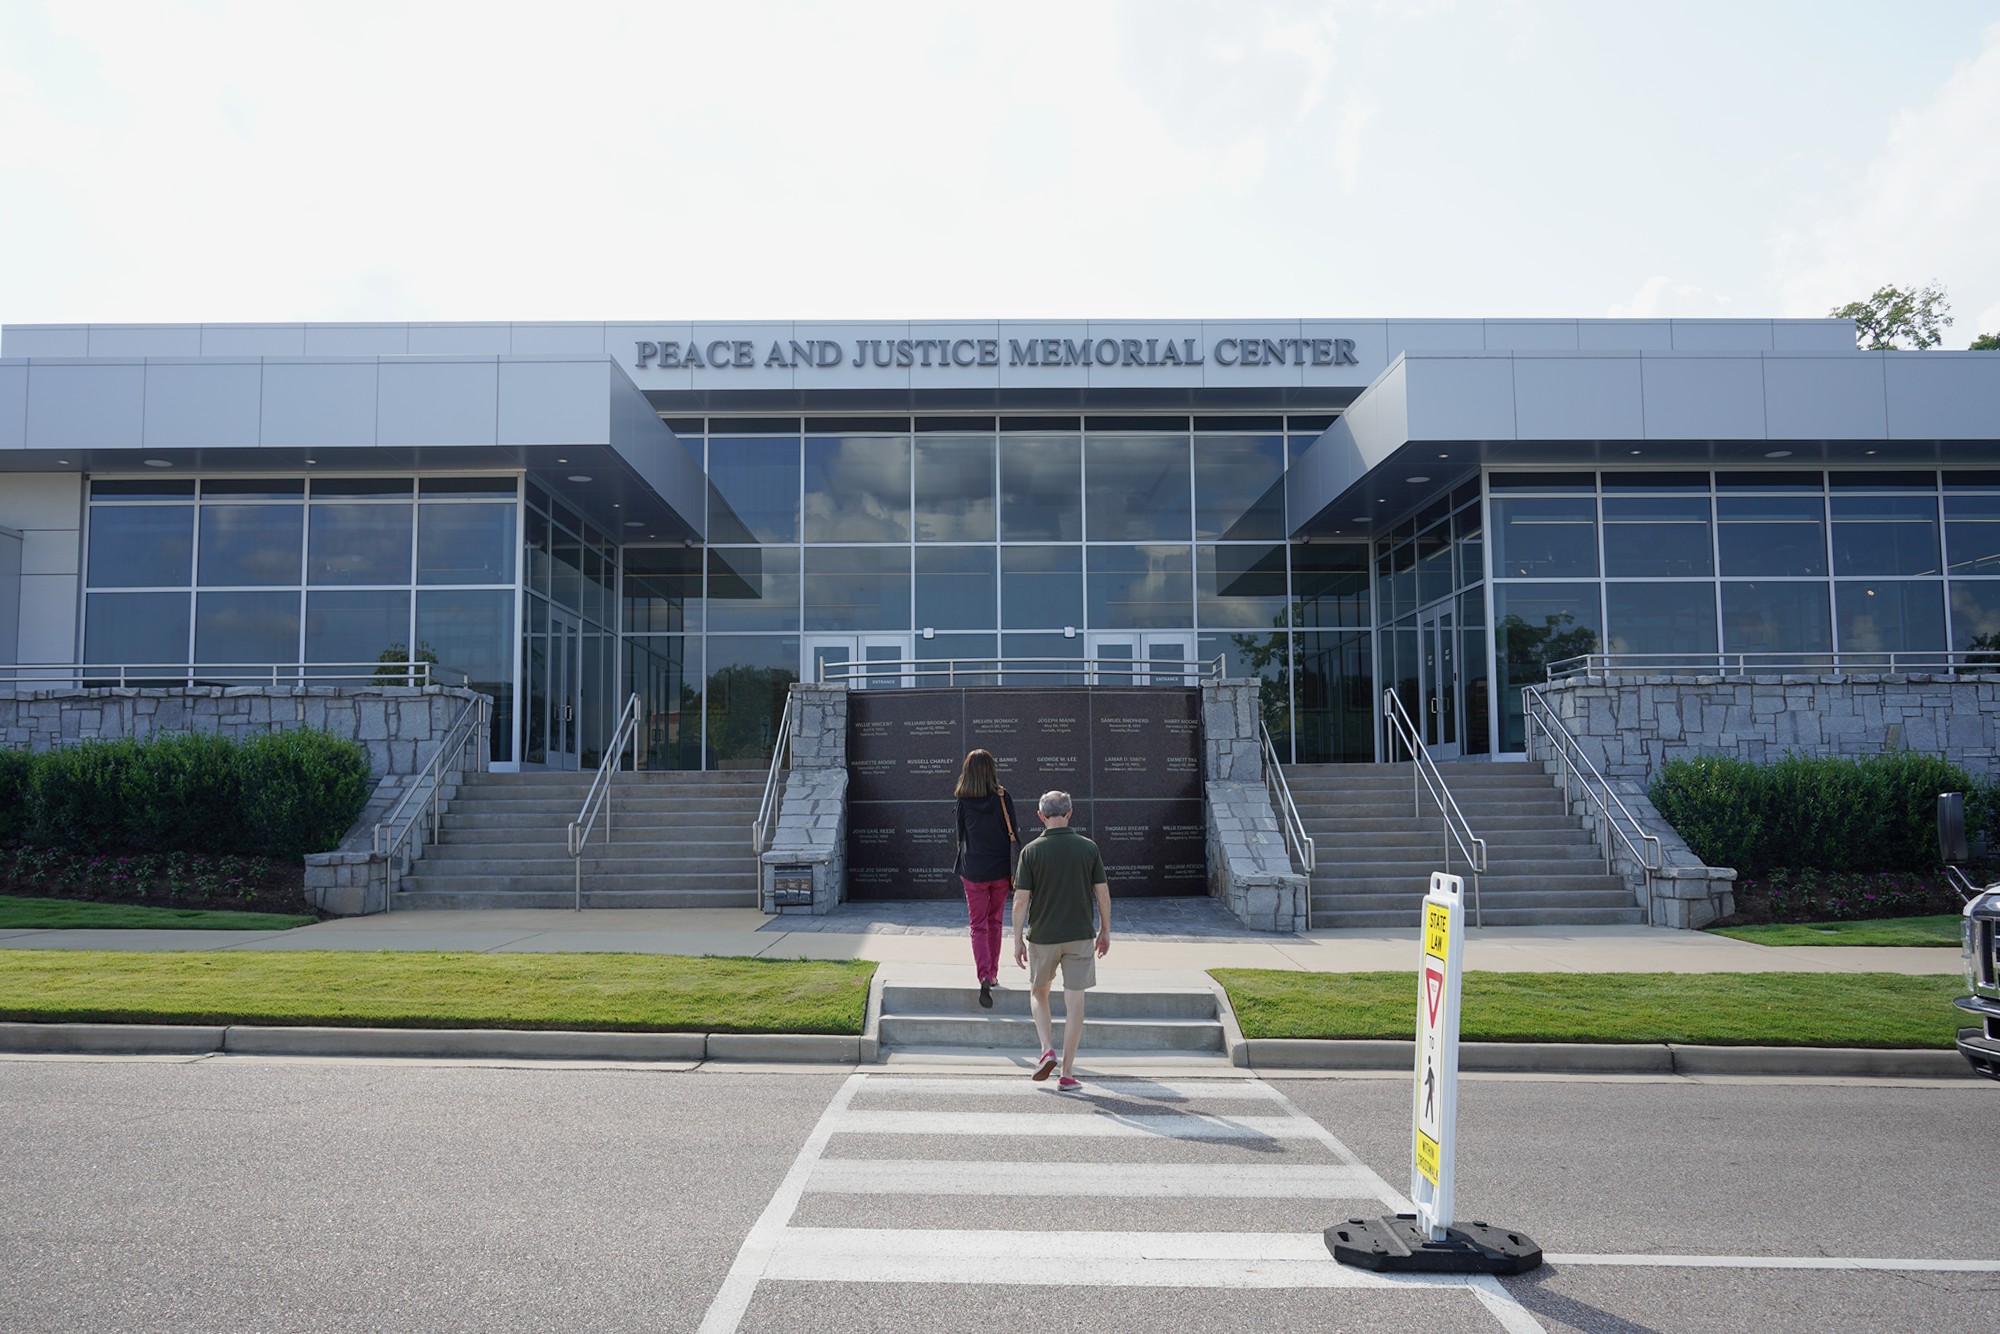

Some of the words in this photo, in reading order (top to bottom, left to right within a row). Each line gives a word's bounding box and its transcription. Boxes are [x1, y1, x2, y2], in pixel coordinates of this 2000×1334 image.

[635, 340, 756, 369] PEACE
[763, 340, 844, 369] AND
[852, 339, 1000, 368] JUSTICE
[1008, 338, 1206, 367] MEMORIAL
[1216, 338, 1360, 367] CENTER
[1429, 912, 1447, 933] STATE
[1430, 933, 1442, 953] LAW
[1429, 1035, 1434, 1050] TO
